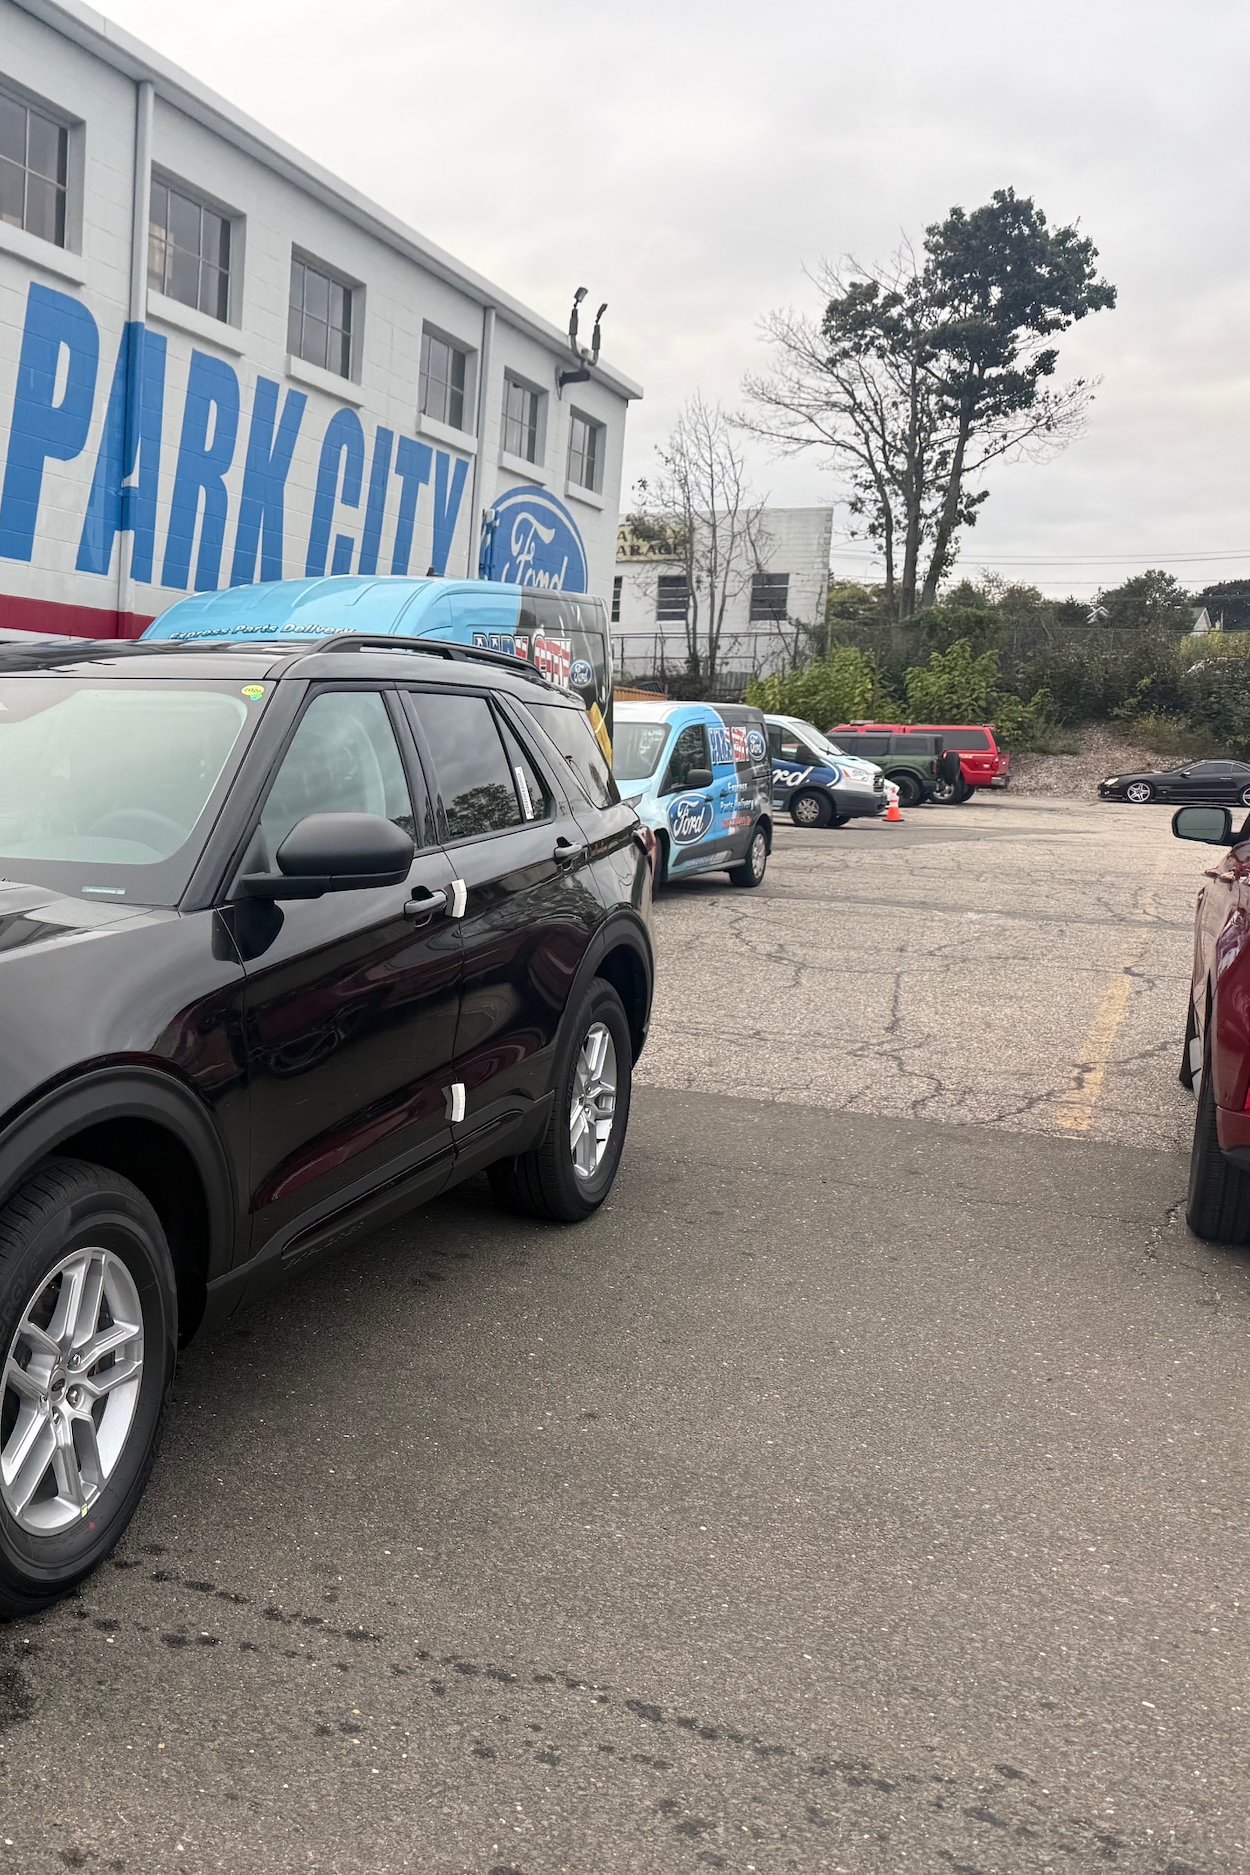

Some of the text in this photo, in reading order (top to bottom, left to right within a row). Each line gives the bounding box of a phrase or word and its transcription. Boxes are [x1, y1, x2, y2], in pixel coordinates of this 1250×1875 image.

[305, 407, 469, 579] CITY
[501, 511, 569, 592] Ford
[168, 623, 357, 640] Express Parts Delivery
[708, 728, 733, 764] PARK
[772, 765, 815, 787] rd
[673, 800, 706, 837] Ford
